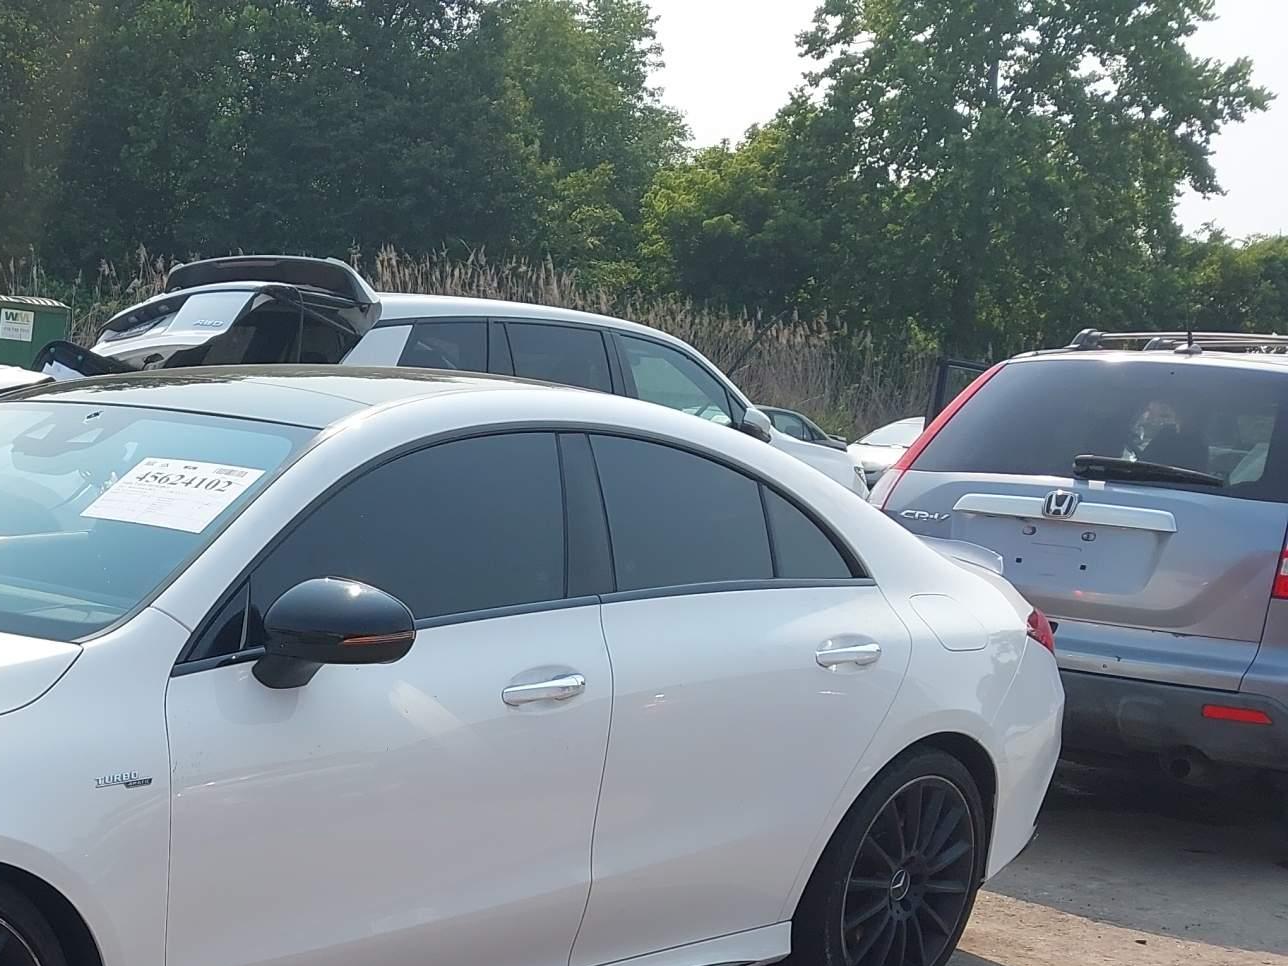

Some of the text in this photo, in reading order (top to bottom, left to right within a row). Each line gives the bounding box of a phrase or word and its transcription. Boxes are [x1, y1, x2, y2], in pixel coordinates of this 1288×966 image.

[5, 311, 30, 322] WM
[136, 471, 233, 492] 45624102
[900, 509, 951, 521] CR-V
[96, 771, 138, 785] TURBO
